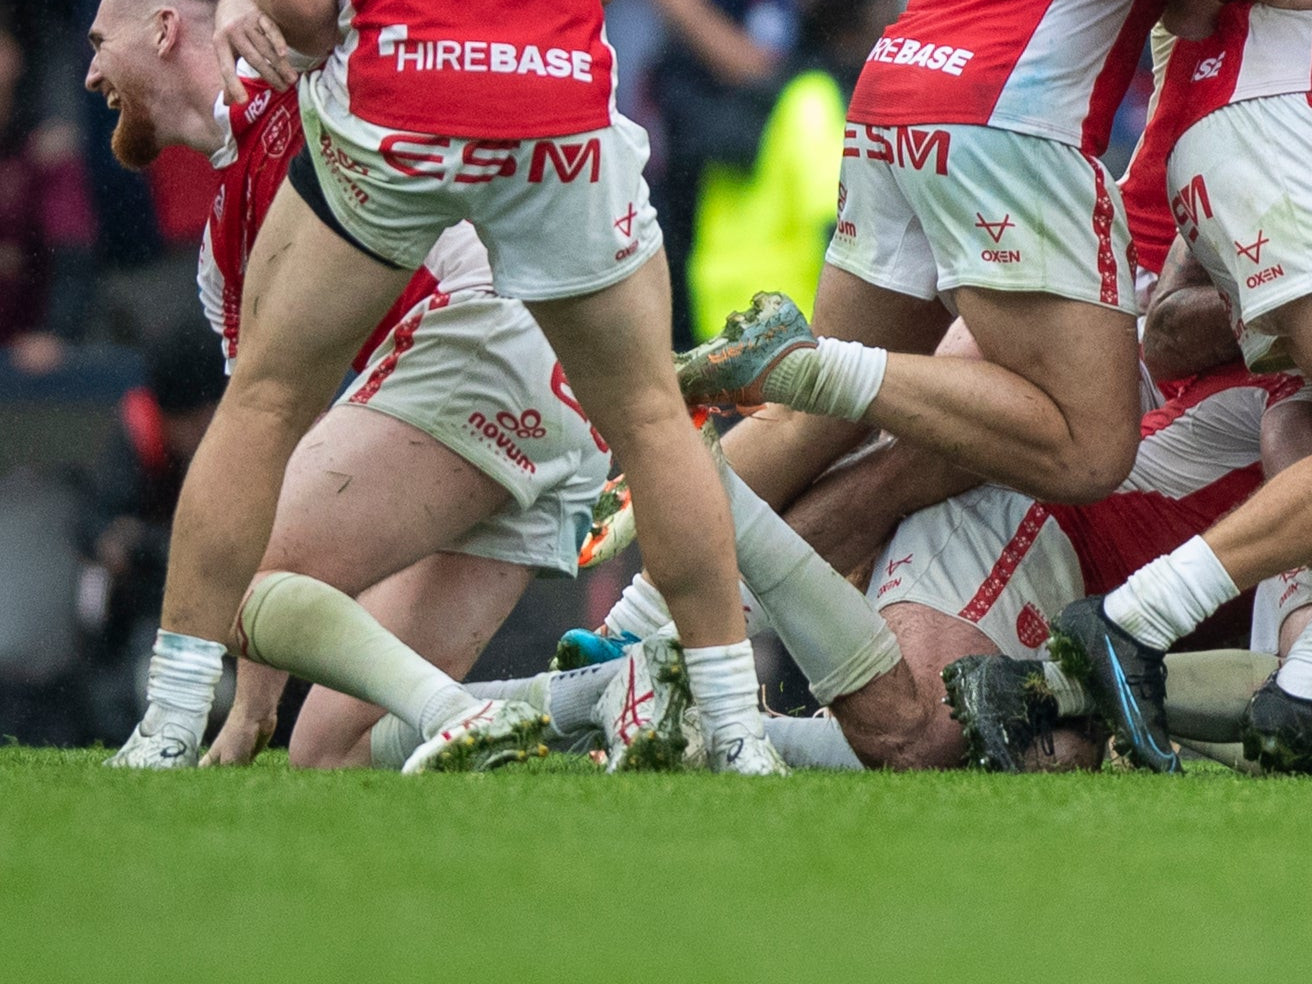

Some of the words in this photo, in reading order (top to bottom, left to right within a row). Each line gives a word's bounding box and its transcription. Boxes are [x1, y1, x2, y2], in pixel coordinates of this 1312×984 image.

[397, 40, 593, 83] HIREBASE
[378, 133, 601, 184] ESM
[981, 250, 1021, 263] OXEN
[1246, 264, 1284, 289] OXEN
[468, 412, 536, 475] novum
